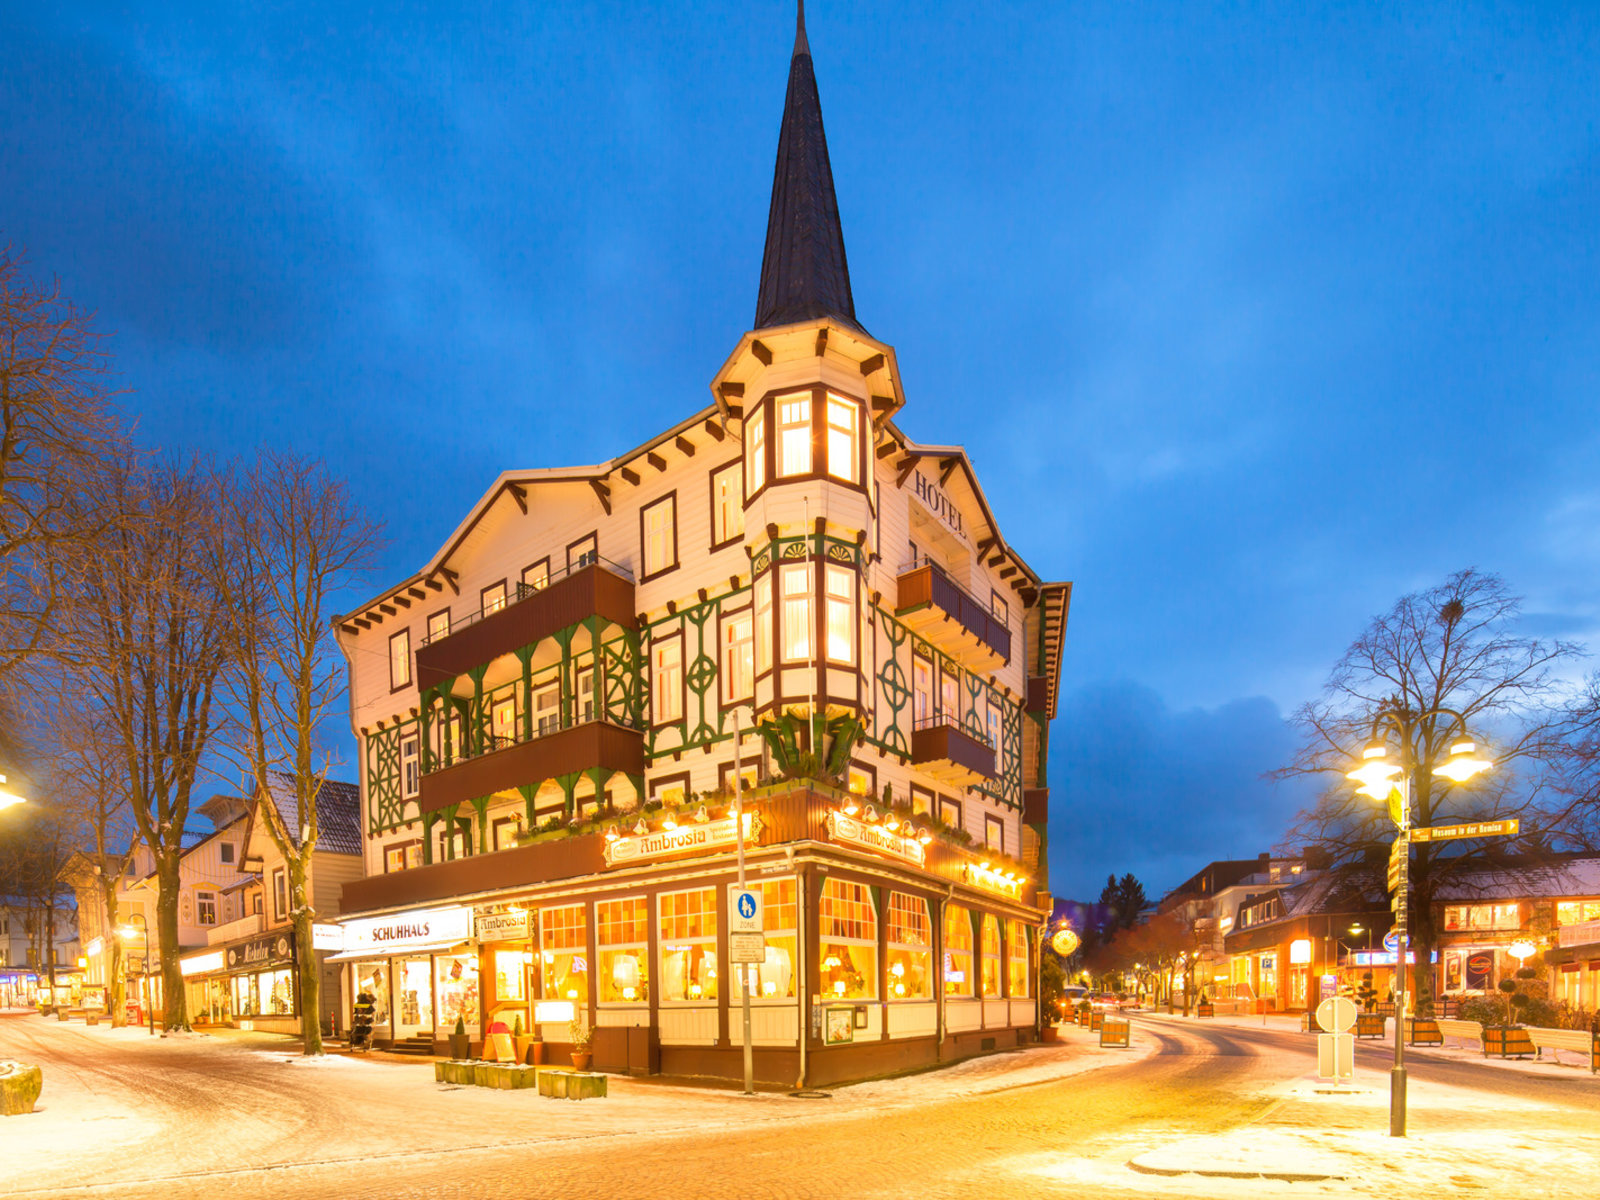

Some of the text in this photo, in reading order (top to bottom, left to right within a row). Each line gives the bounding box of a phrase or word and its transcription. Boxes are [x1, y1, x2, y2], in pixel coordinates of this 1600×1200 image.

[915, 468, 967, 540] HOTEL
[640, 829, 706, 854] Ambrosia
[860, 825, 902, 853] Ambrosia
[372, 921, 430, 942] SCHUHHAUS
[480, 915, 527, 930] Ambrosia
[739, 921, 756, 929] ZONE
